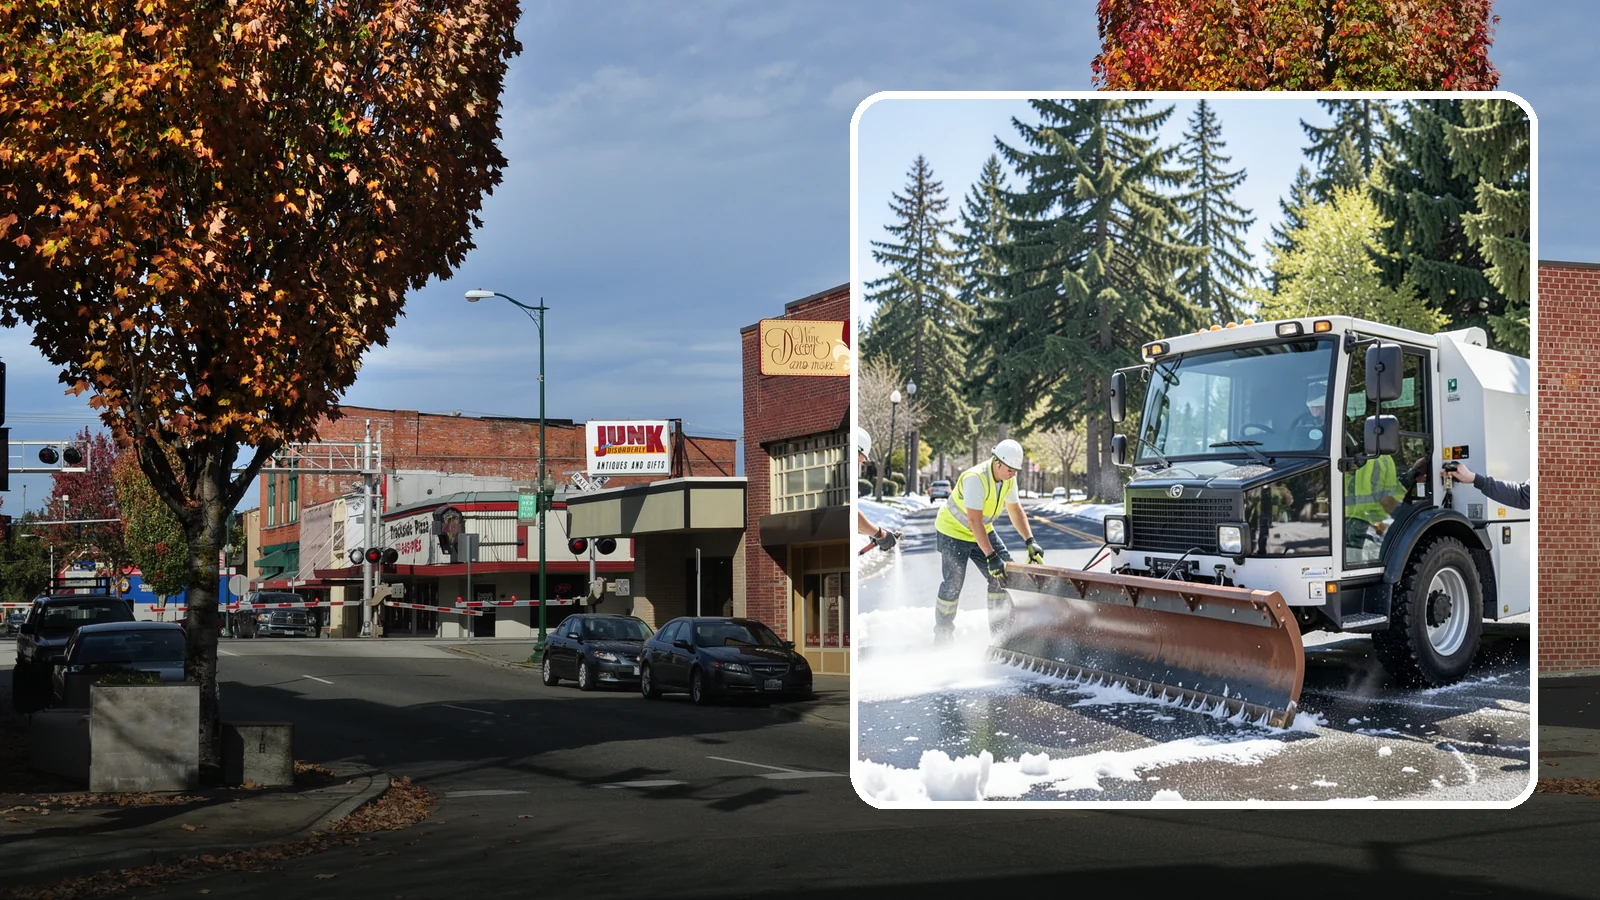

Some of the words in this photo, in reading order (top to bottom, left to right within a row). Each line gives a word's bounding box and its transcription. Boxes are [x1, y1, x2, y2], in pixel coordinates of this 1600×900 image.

[595, 425, 666, 457] JUNK
[607, 446, 646, 454] DISORDERLY
[597, 461, 628, 470] ANTIQUES
[631, 461, 644, 470] AND
[647, 461, 665, 469] GIFTS
[414, 519, 429, 535] Pizza
